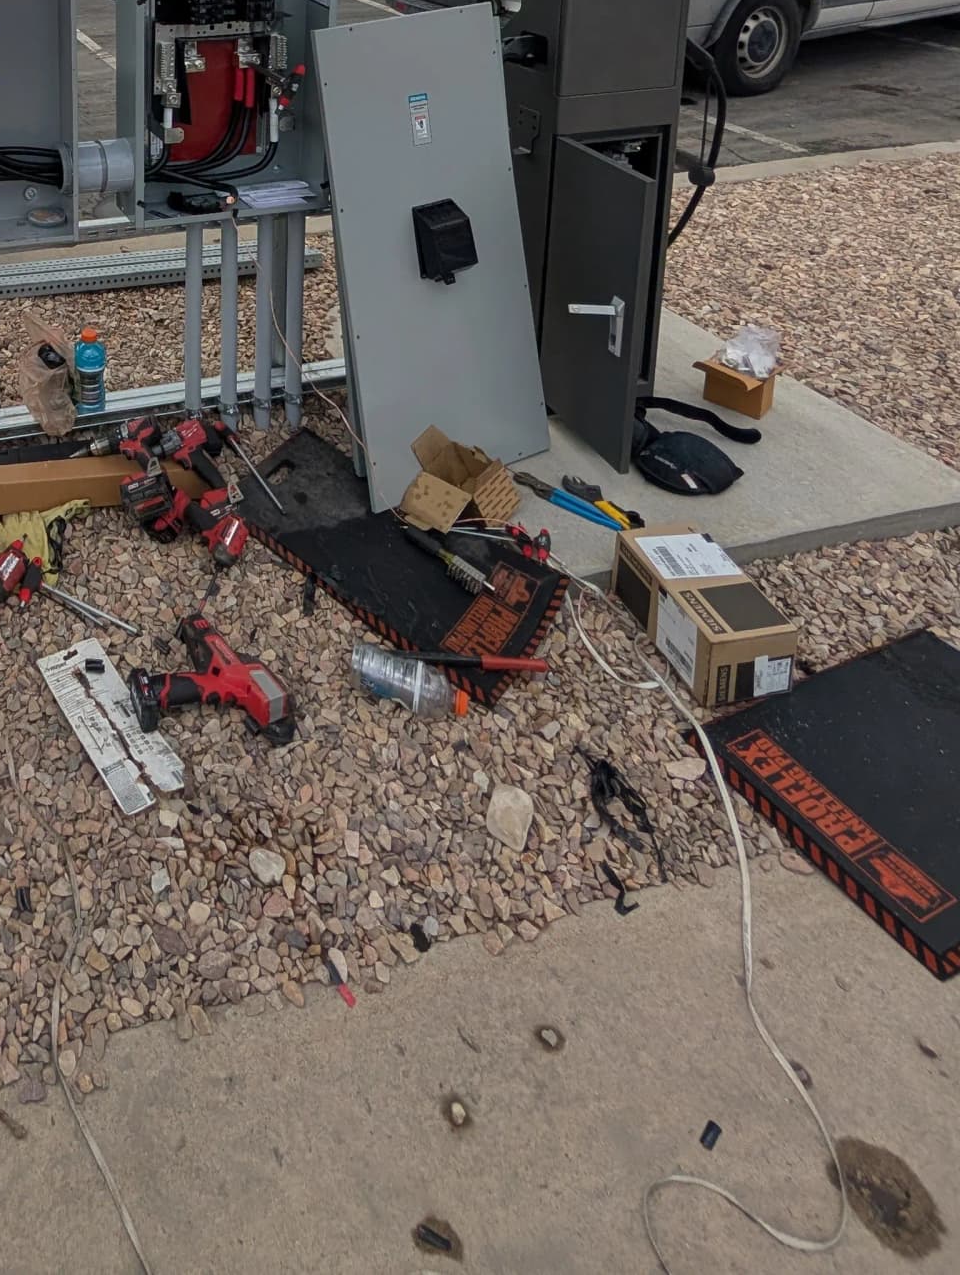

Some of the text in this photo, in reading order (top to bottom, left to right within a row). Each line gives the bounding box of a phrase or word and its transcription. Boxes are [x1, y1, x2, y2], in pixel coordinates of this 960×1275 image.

[682, 591, 723, 633] SIEMENS
[739, 739, 867, 856] PROFLEX
[755, 737, 880, 844] KNEELING PAD
